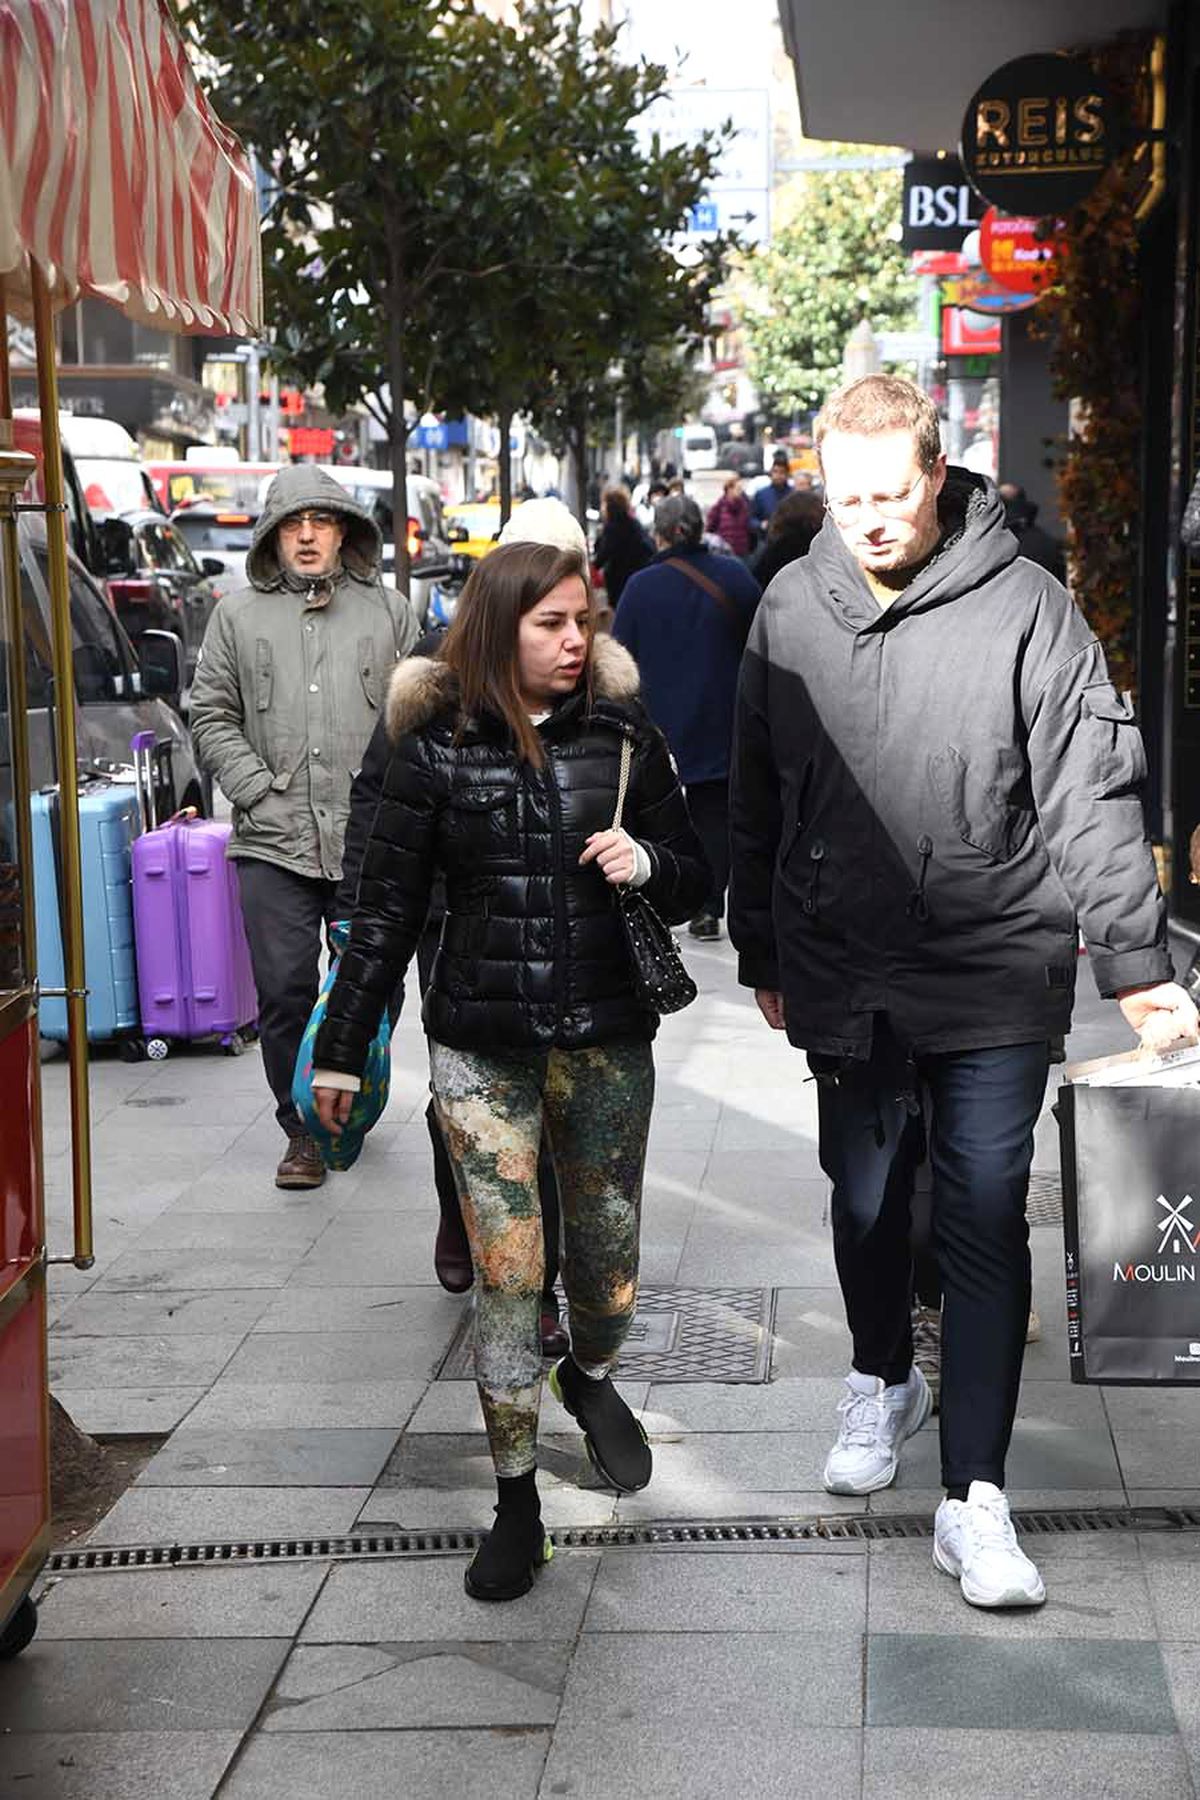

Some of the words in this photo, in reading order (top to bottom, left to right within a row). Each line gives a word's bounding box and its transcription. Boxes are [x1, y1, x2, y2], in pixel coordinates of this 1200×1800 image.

[976, 95, 1104, 147] REIS
[909, 185, 977, 227] BSL
[1113, 1262, 1196, 1282] MOULIN
